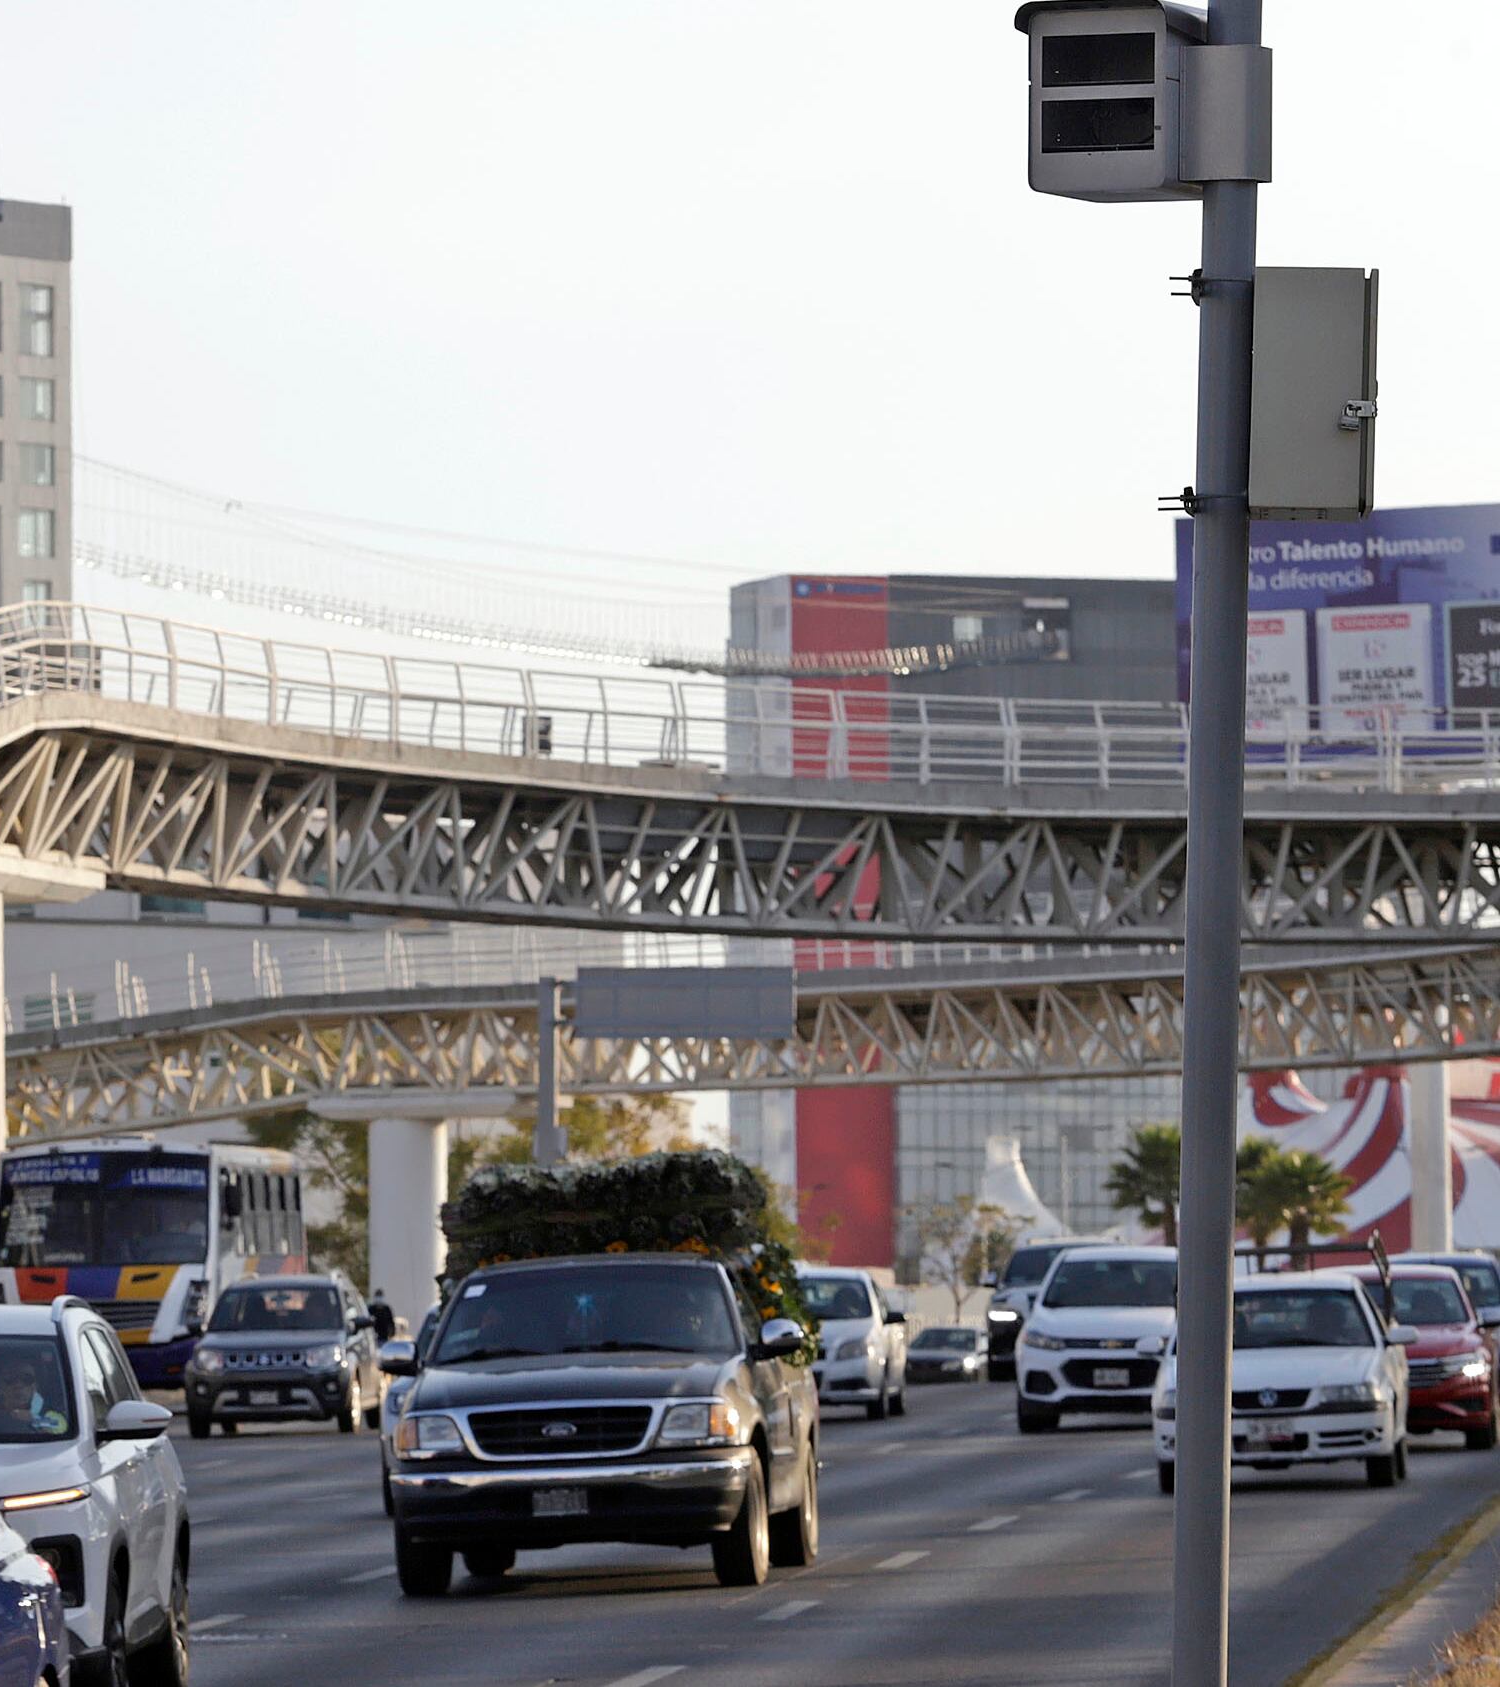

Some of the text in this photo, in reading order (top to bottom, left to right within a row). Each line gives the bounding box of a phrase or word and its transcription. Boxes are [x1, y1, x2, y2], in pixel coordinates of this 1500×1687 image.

[1276, 538, 1364, 562] Talento
[1366, 536, 1465, 558] Humano
[1270, 566, 1374, 590] diferencia
